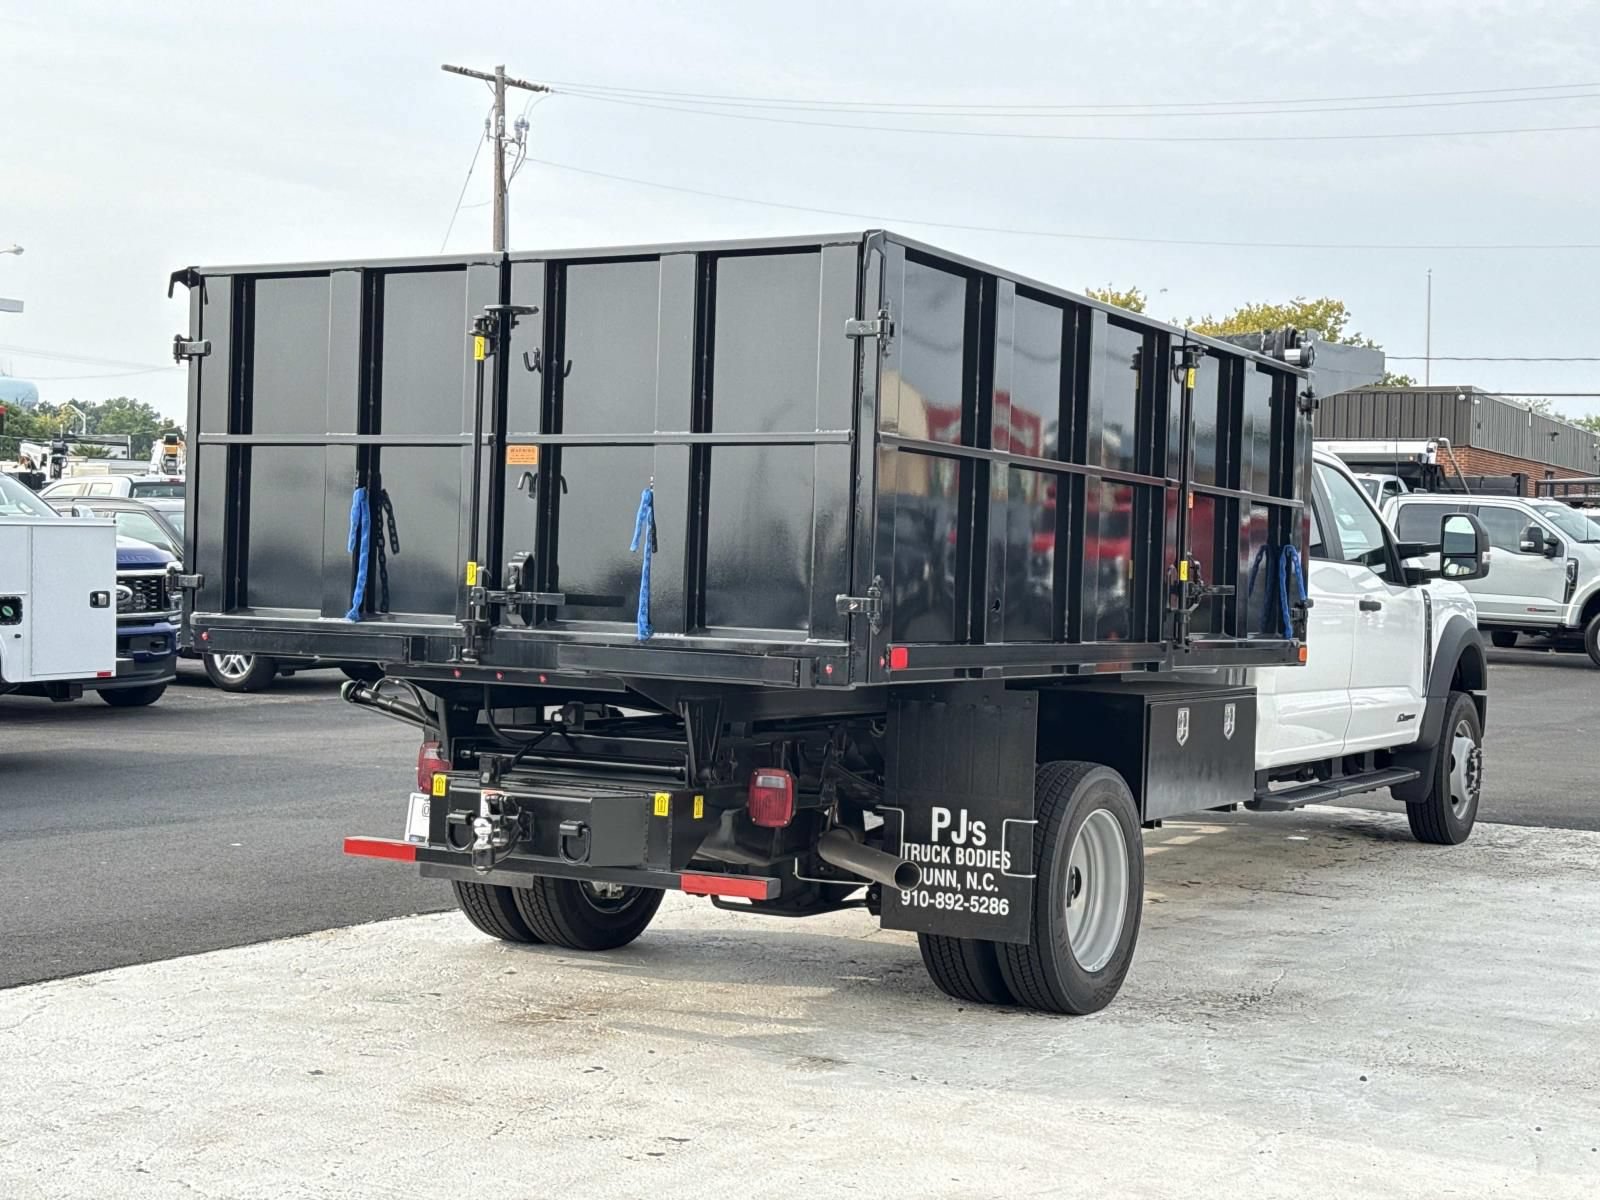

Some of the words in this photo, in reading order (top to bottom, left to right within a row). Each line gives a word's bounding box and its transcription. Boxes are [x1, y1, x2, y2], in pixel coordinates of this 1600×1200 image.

[931, 806, 987, 846] PJ's
[903, 843, 951, 864] TRUCK
[955, 848, 1011, 870] BODIES
[922, 867, 962, 891] UNN,
[966, 871, 999, 892] N.C.
[901, 890, 1009, 915] 910-892-5286
